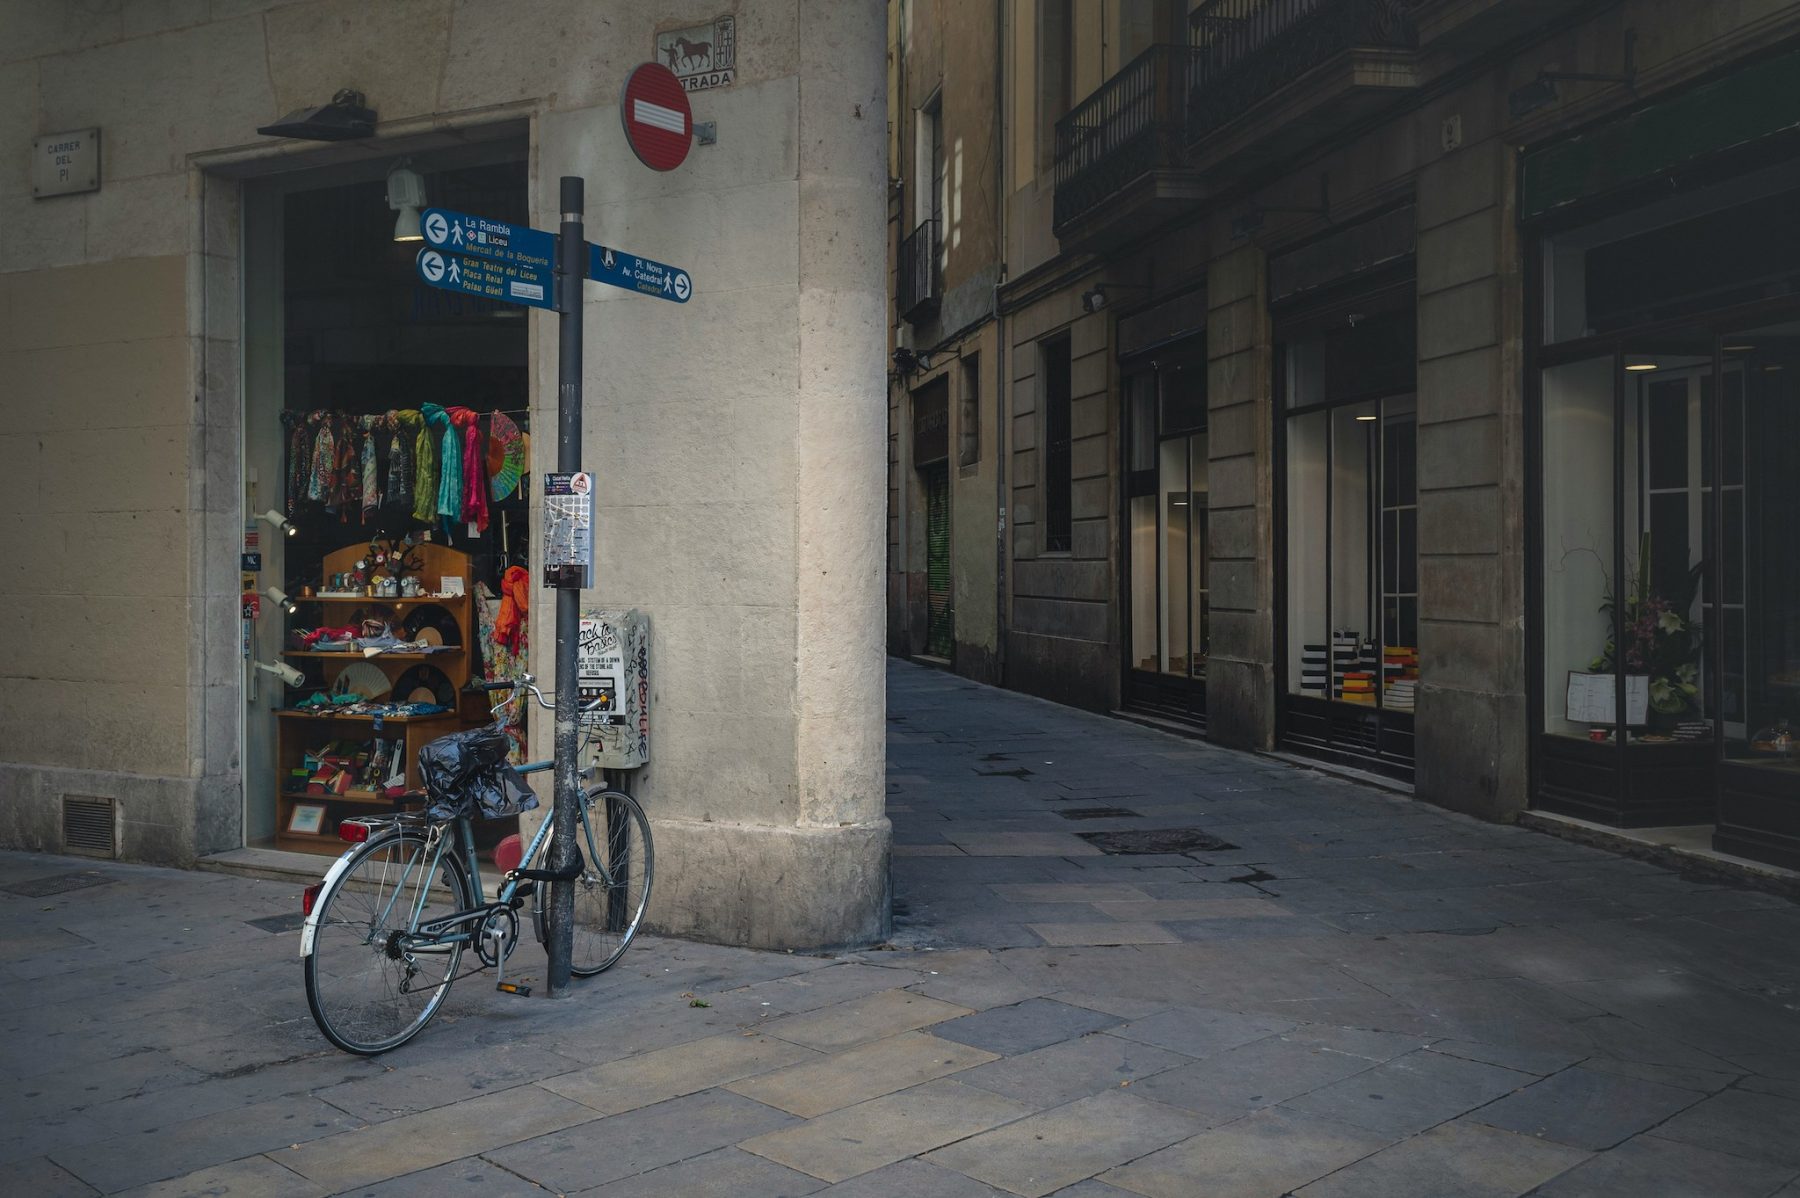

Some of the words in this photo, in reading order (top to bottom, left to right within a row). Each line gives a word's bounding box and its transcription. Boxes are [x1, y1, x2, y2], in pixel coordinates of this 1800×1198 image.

[680, 72, 731, 90] TRADA
[47, 141, 81, 154] CARRER
[56, 155, 72, 166] DEL
[59, 168, 69, 182] PI
[466, 217, 476, 228] La
[480, 220, 511, 235] Rambla
[489, 236, 508, 246] Liceu
[466, 244, 492, 255] Mercat
[494, 249, 504, 258] de
[507, 250, 514, 258] la
[517, 252, 548, 265] Boqueria
[463, 258, 479, 267] Gran
[483, 262, 503, 273] Teatre
[506, 267, 517, 277] del
[520, 270, 538, 281] Liceu
[646, 262, 663, 275] Nova
[486, 274, 503, 284] Reial
[622, 266, 632, 277] Av.
[634, 270, 663, 285] Catedral
[463, 281, 482, 292] Palau
[637, 282, 662, 295] Catedral
[579, 623, 598, 641] ack
